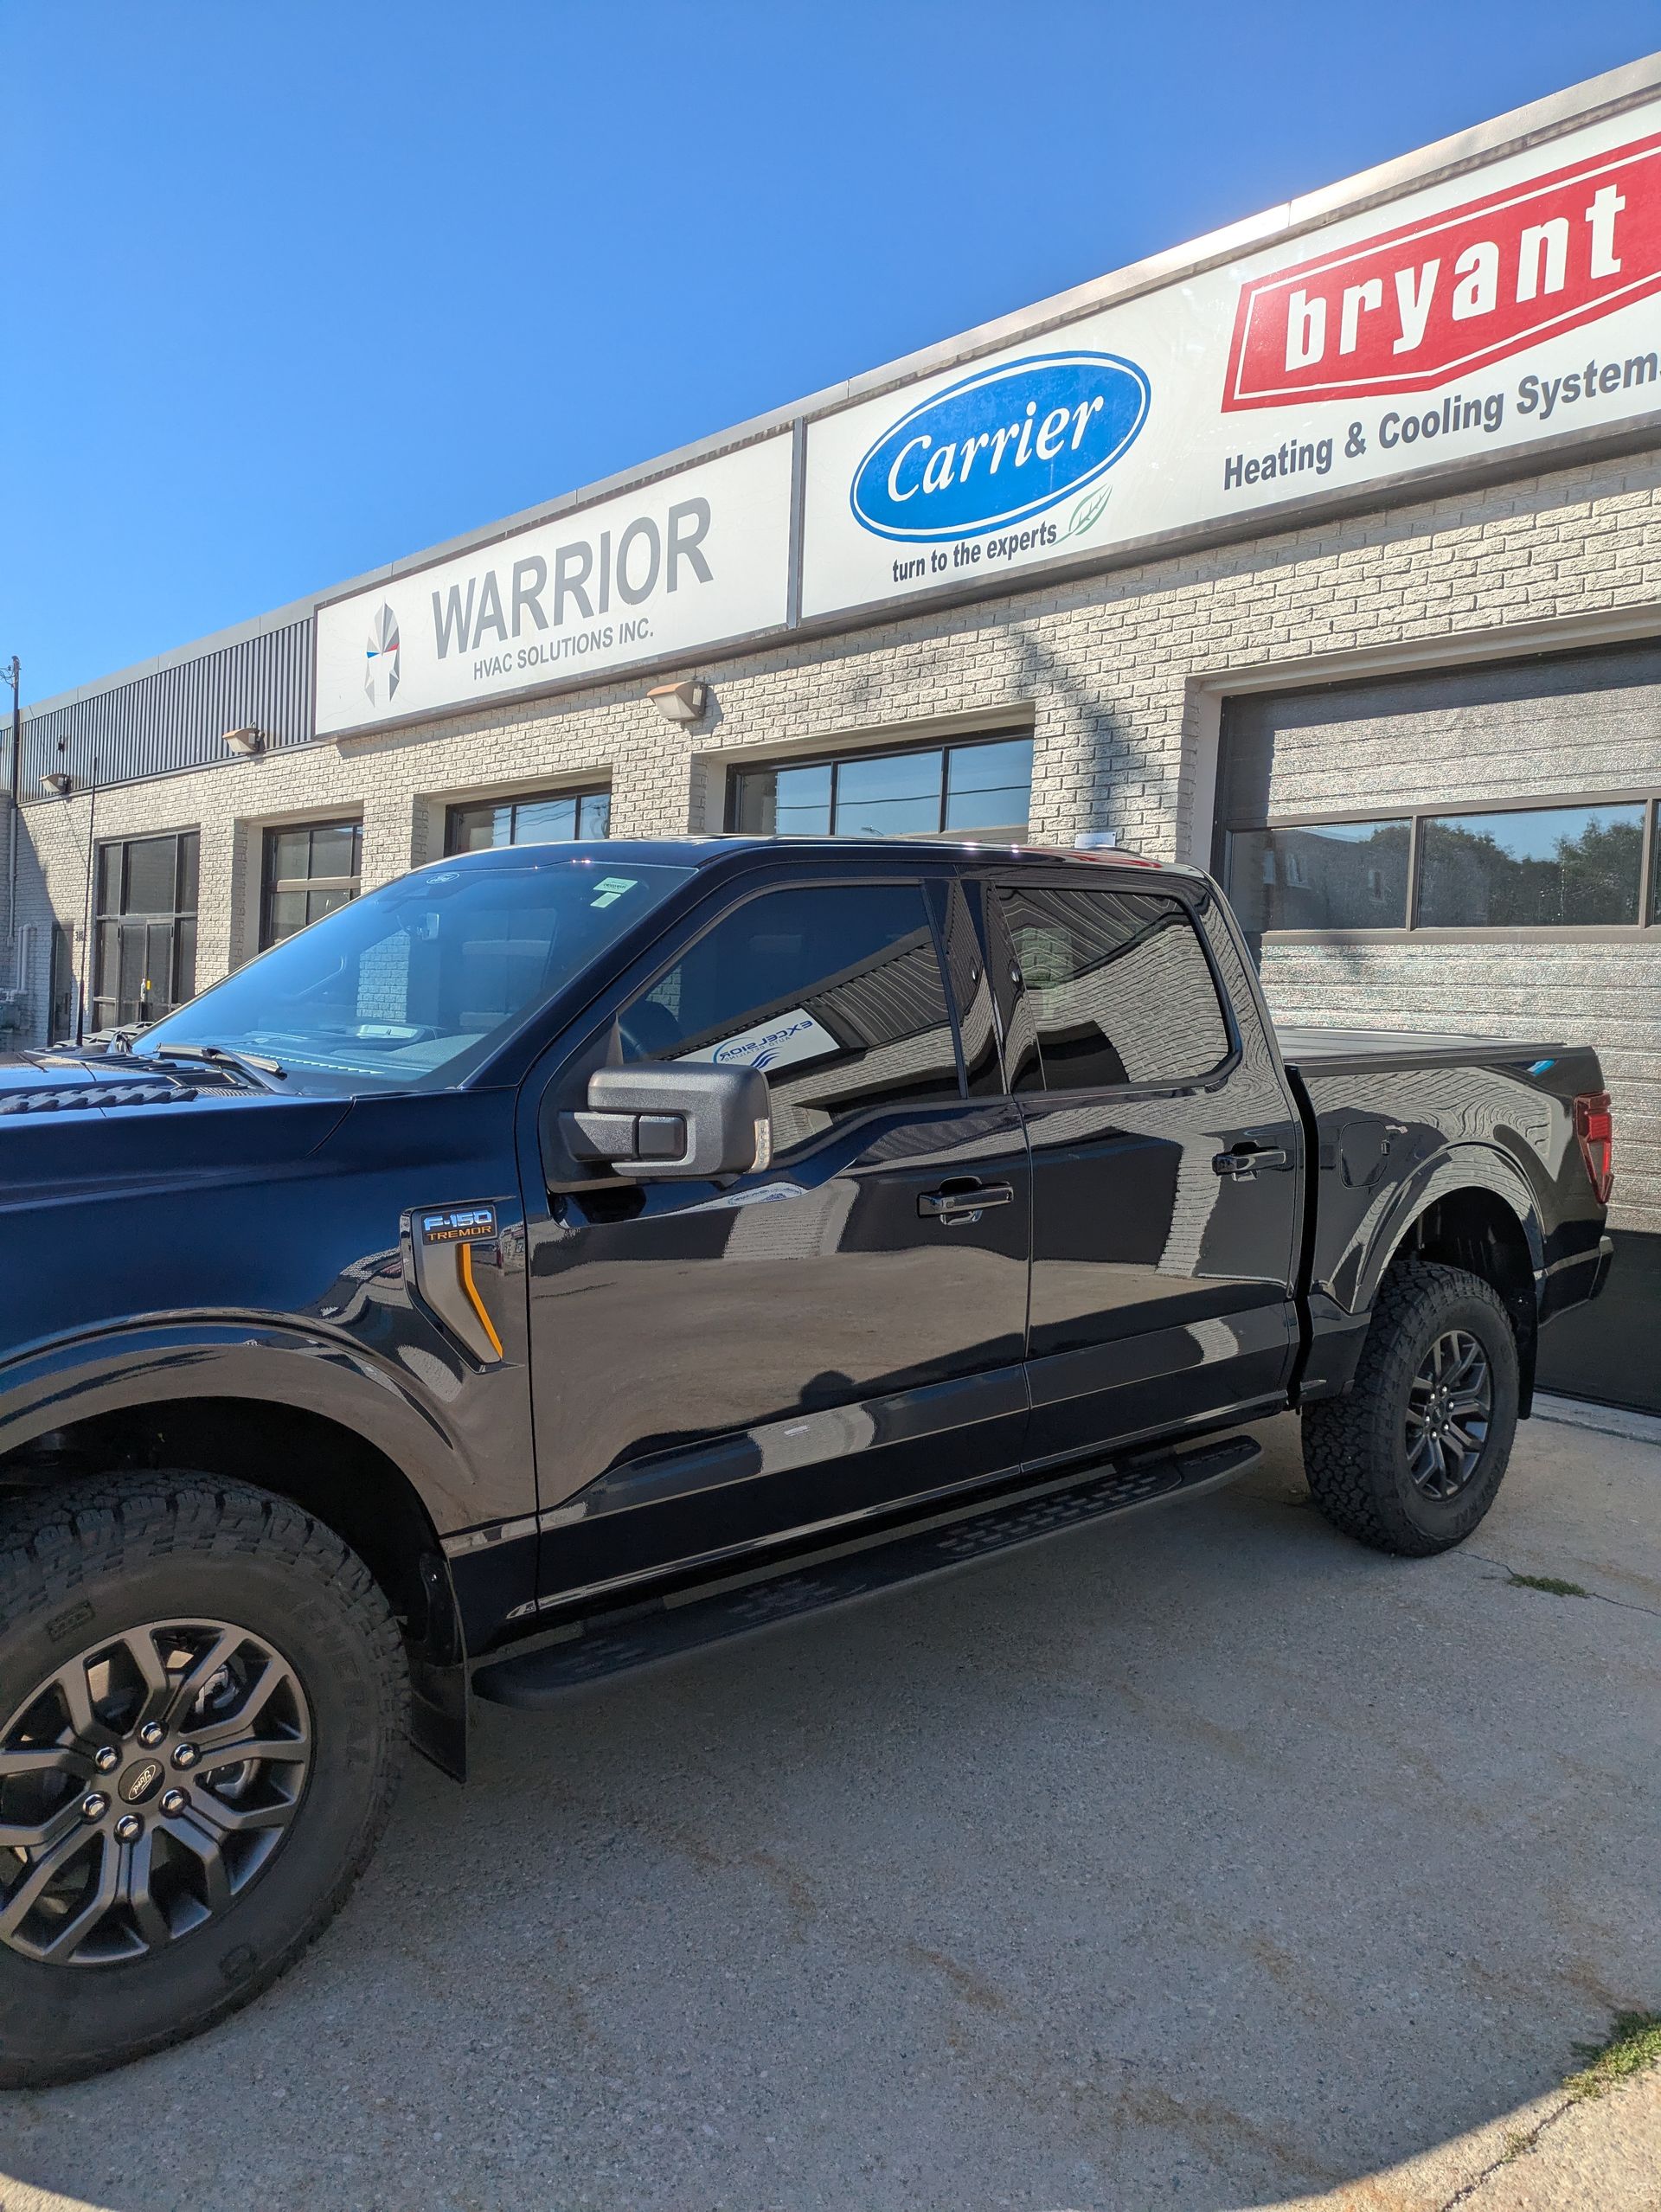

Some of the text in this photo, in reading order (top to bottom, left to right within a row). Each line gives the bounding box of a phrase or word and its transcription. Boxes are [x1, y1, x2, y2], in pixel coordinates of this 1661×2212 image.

[1285, 183, 1626, 372] bryant
[888, 395, 1104, 502] Carrier
[1223, 352, 1661, 490] Heating & Cooling System
[432, 497, 715, 659] WARRIOR
[893, 521, 1057, 582] turn to the experts
[473, 618, 654, 680] HVAC SOLUTIONS INC.
[423, 1210, 491, 1231] F-150
[426, 1225, 491, 1241] TREMOR
[131, 1769, 152, 1795] Ford
